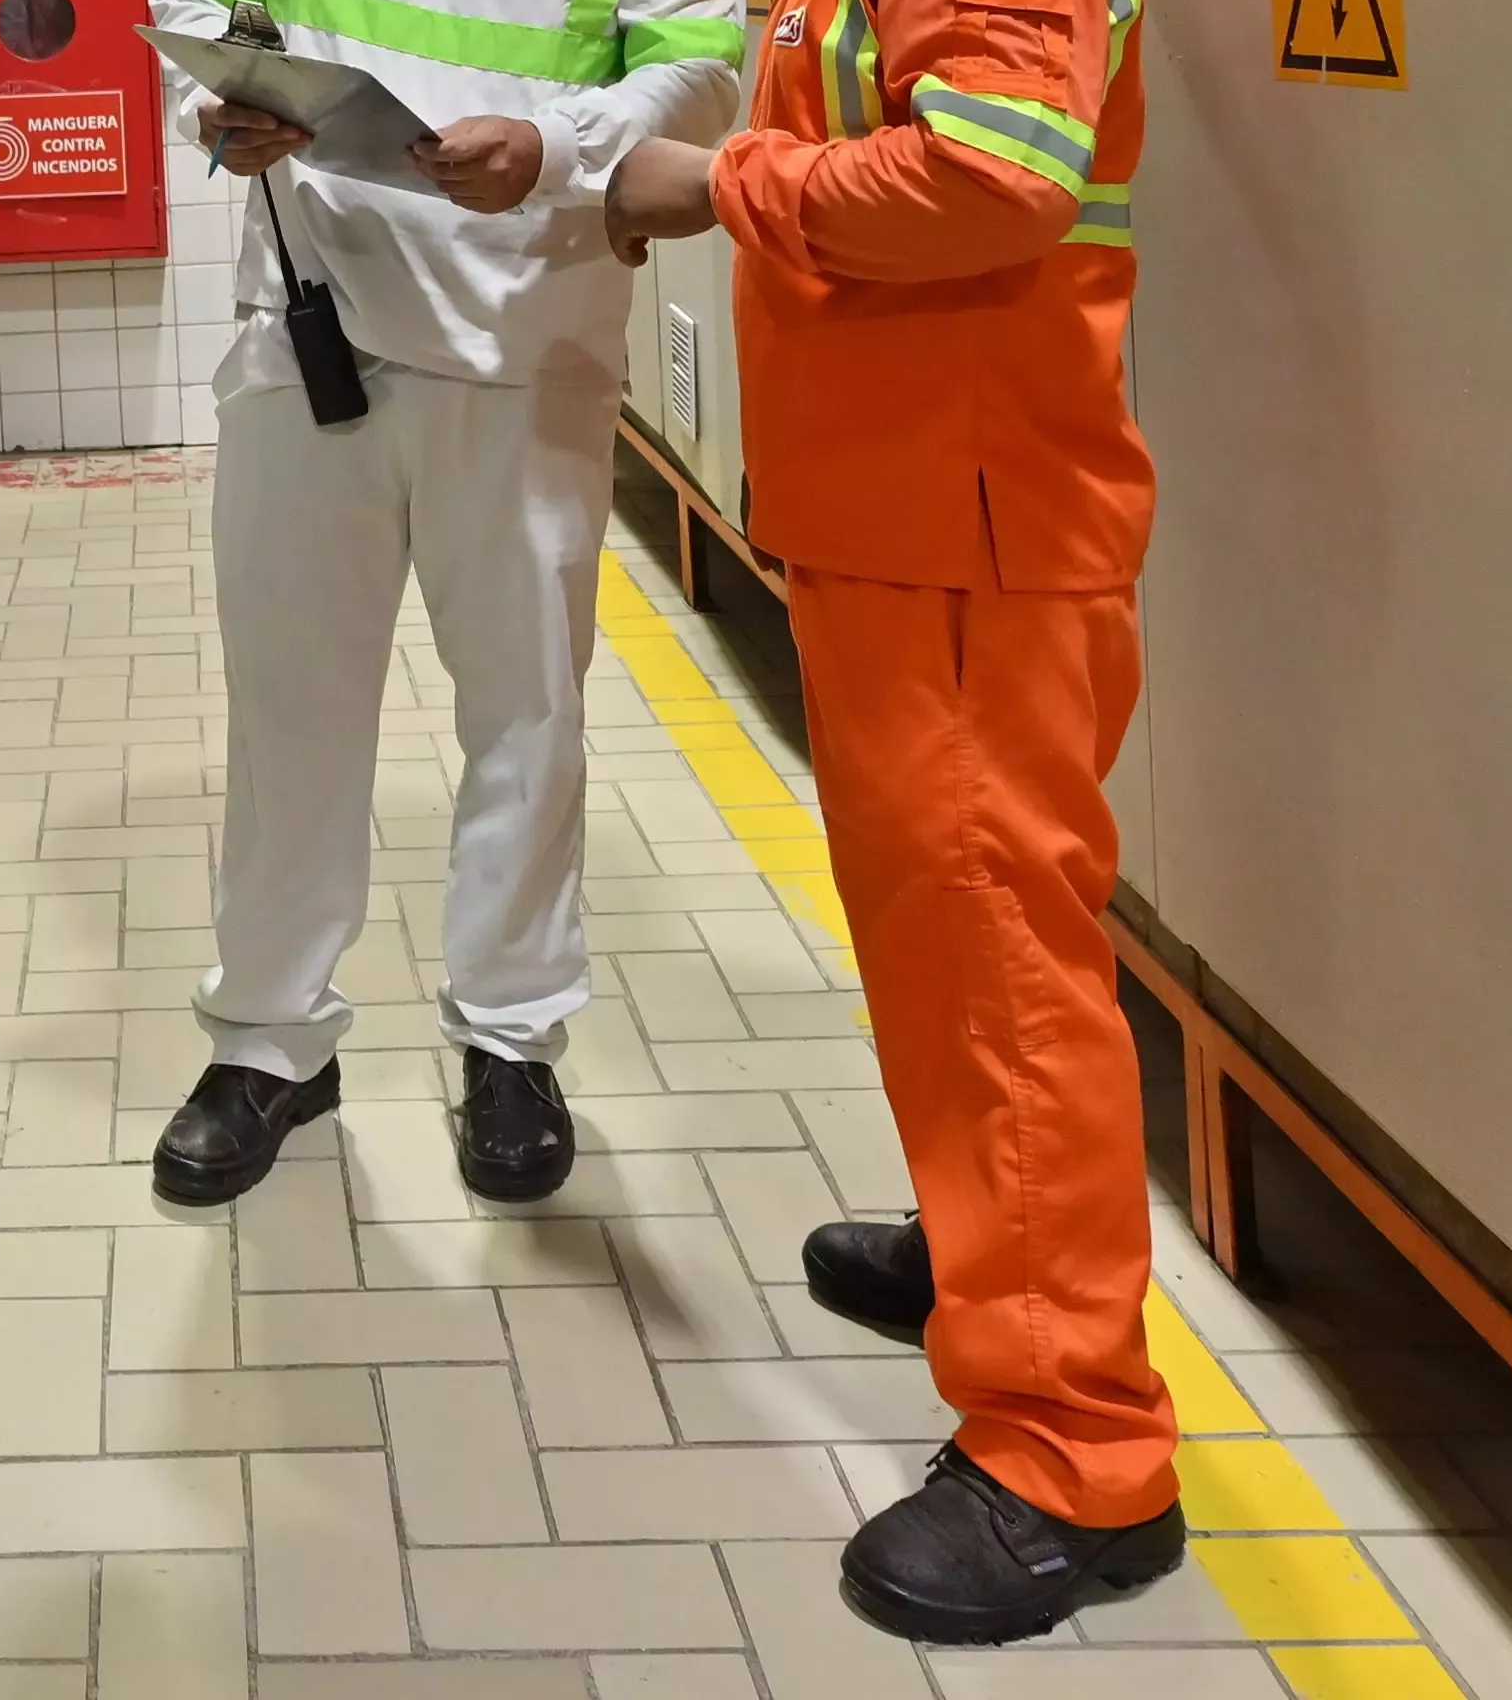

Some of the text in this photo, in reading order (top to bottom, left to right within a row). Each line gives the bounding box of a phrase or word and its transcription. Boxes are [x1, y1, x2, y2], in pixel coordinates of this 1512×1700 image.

[28, 115, 118, 132] MANGUERA
[41, 137, 106, 153] CONTRA
[32, 158, 118, 175] INCENDIOS
